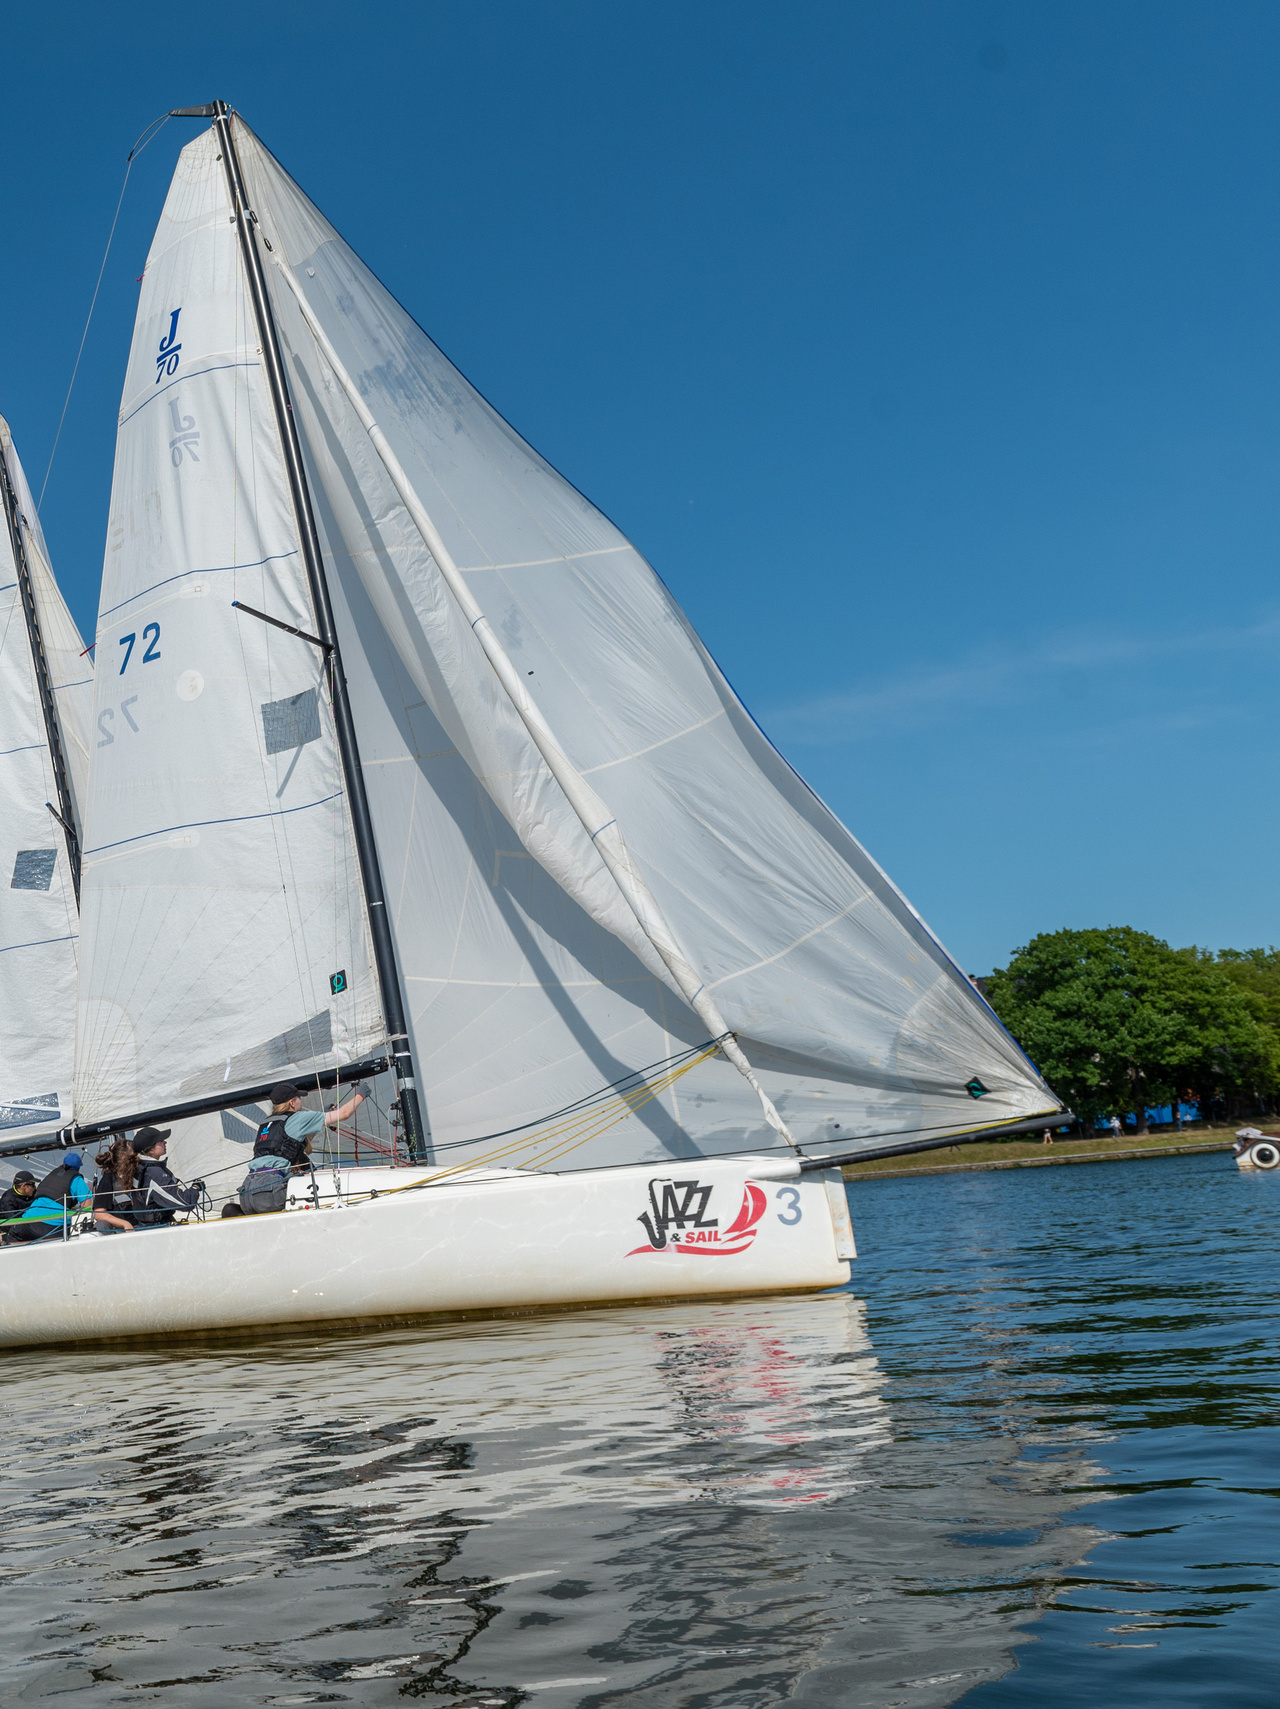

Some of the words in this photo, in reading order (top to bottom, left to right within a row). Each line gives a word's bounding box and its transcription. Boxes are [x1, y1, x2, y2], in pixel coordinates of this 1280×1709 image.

[159, 307, 181, 345] J
[156, 351, 179, 384] 70
[119, 621, 162, 675] 72
[637, 1178, 718, 1250] JAZZ
[775, 1187, 803, 1226] 3
[670, 1232, 681, 1243] &
[685, 1230, 722, 1244] SAIL
